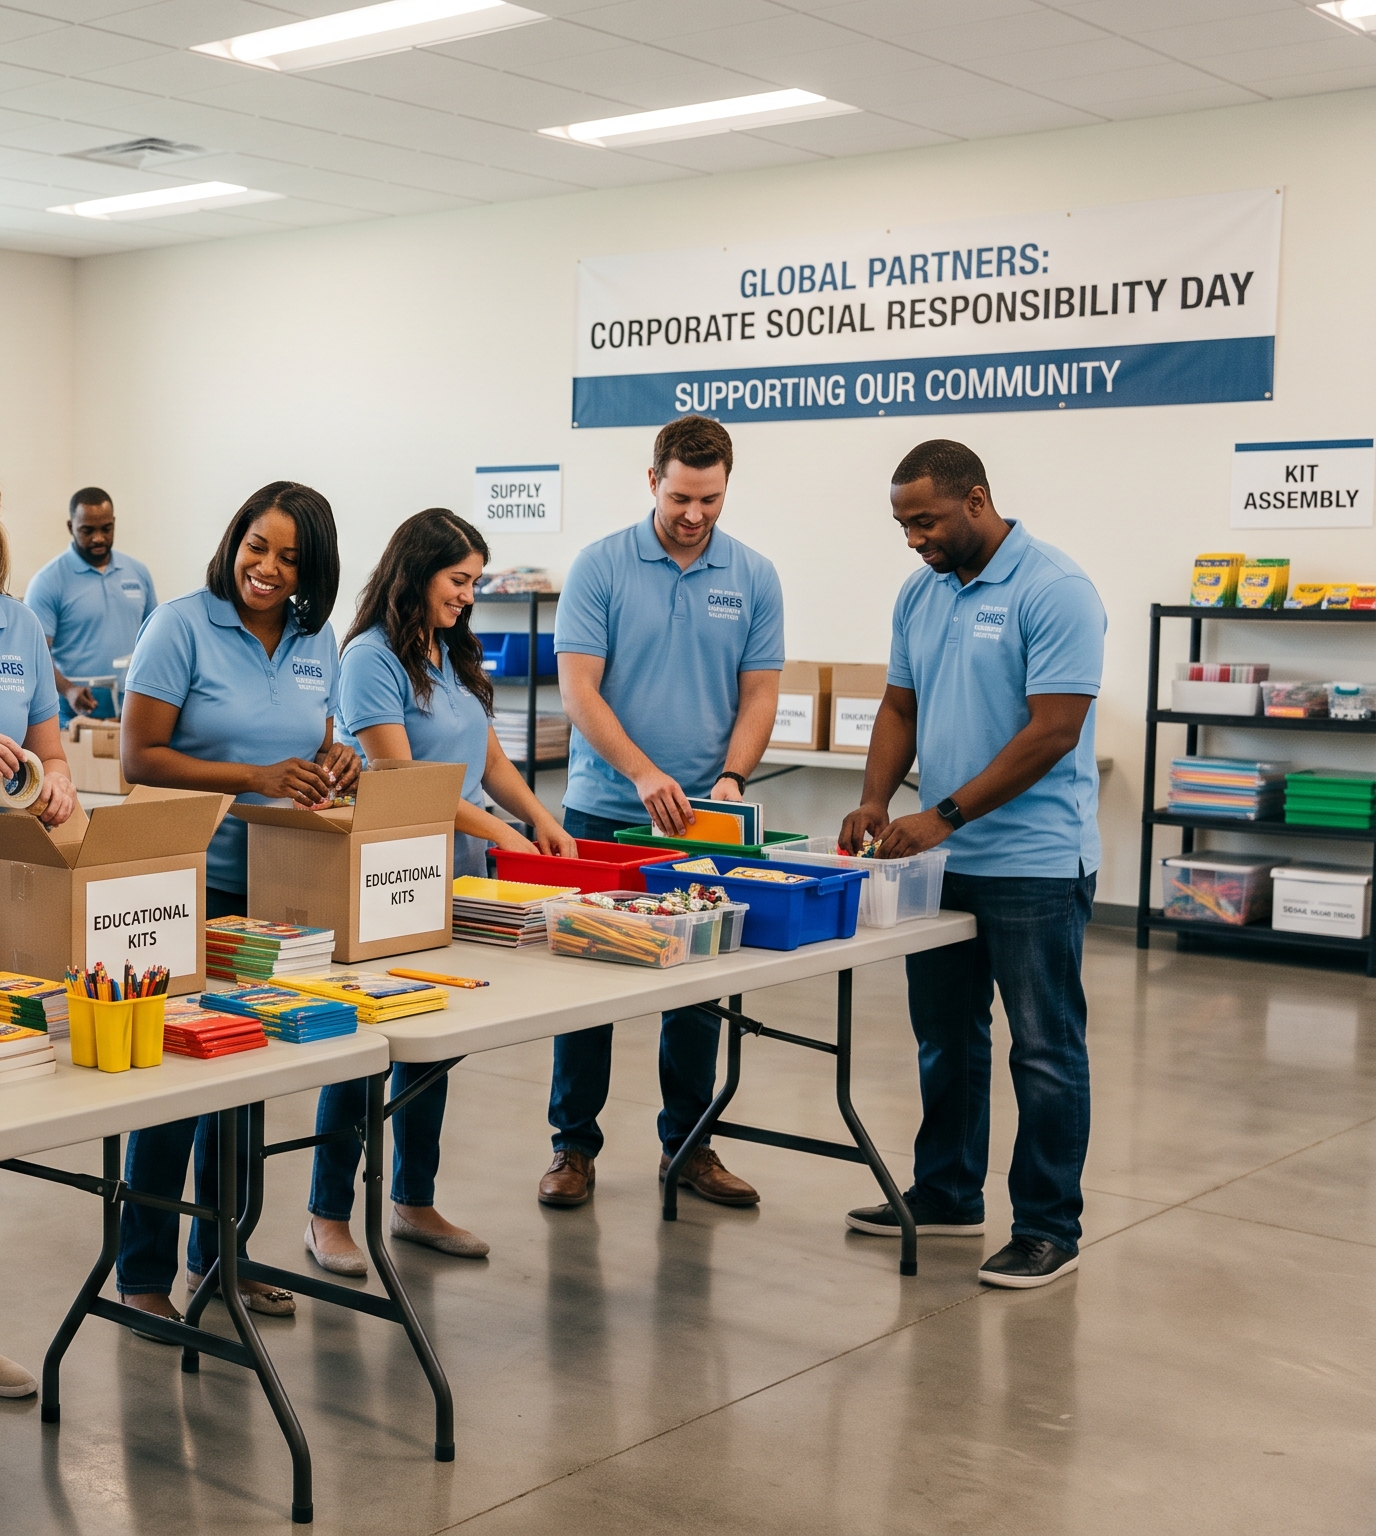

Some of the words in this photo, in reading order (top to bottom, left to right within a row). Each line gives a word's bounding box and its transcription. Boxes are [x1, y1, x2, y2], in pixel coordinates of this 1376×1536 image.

[740, 260, 856, 299] GLOBAL
[868, 243, 1049, 289] PARTNERS:
[590, 311, 756, 350] CORPORATE
[766, 302, 875, 339] SOCIAL
[886, 278, 1168, 331] RESPONSIBILITY
[1180, 271, 1255, 310] DAY
[675, 374, 846, 413] SUPPORTING
[854, 371, 916, 404] OUR
[925, 359, 1122, 402] COMMUNITY
[1285, 464, 1319, 484] KIT
[490, 483, 542, 500] SUPPLY
[1243, 489, 1360, 510] ASSEMBLY
[487, 503, 546, 520] SORTING
[708, 595, 742, 608] CARES
[292, 663, 322, 678] CARES
[365, 864, 442, 888] EDUCATIONAL
[390, 889, 415, 906] KITS
[93, 904, 190, 931] EDUCATIONAL
[128, 930, 157, 950] KITS
